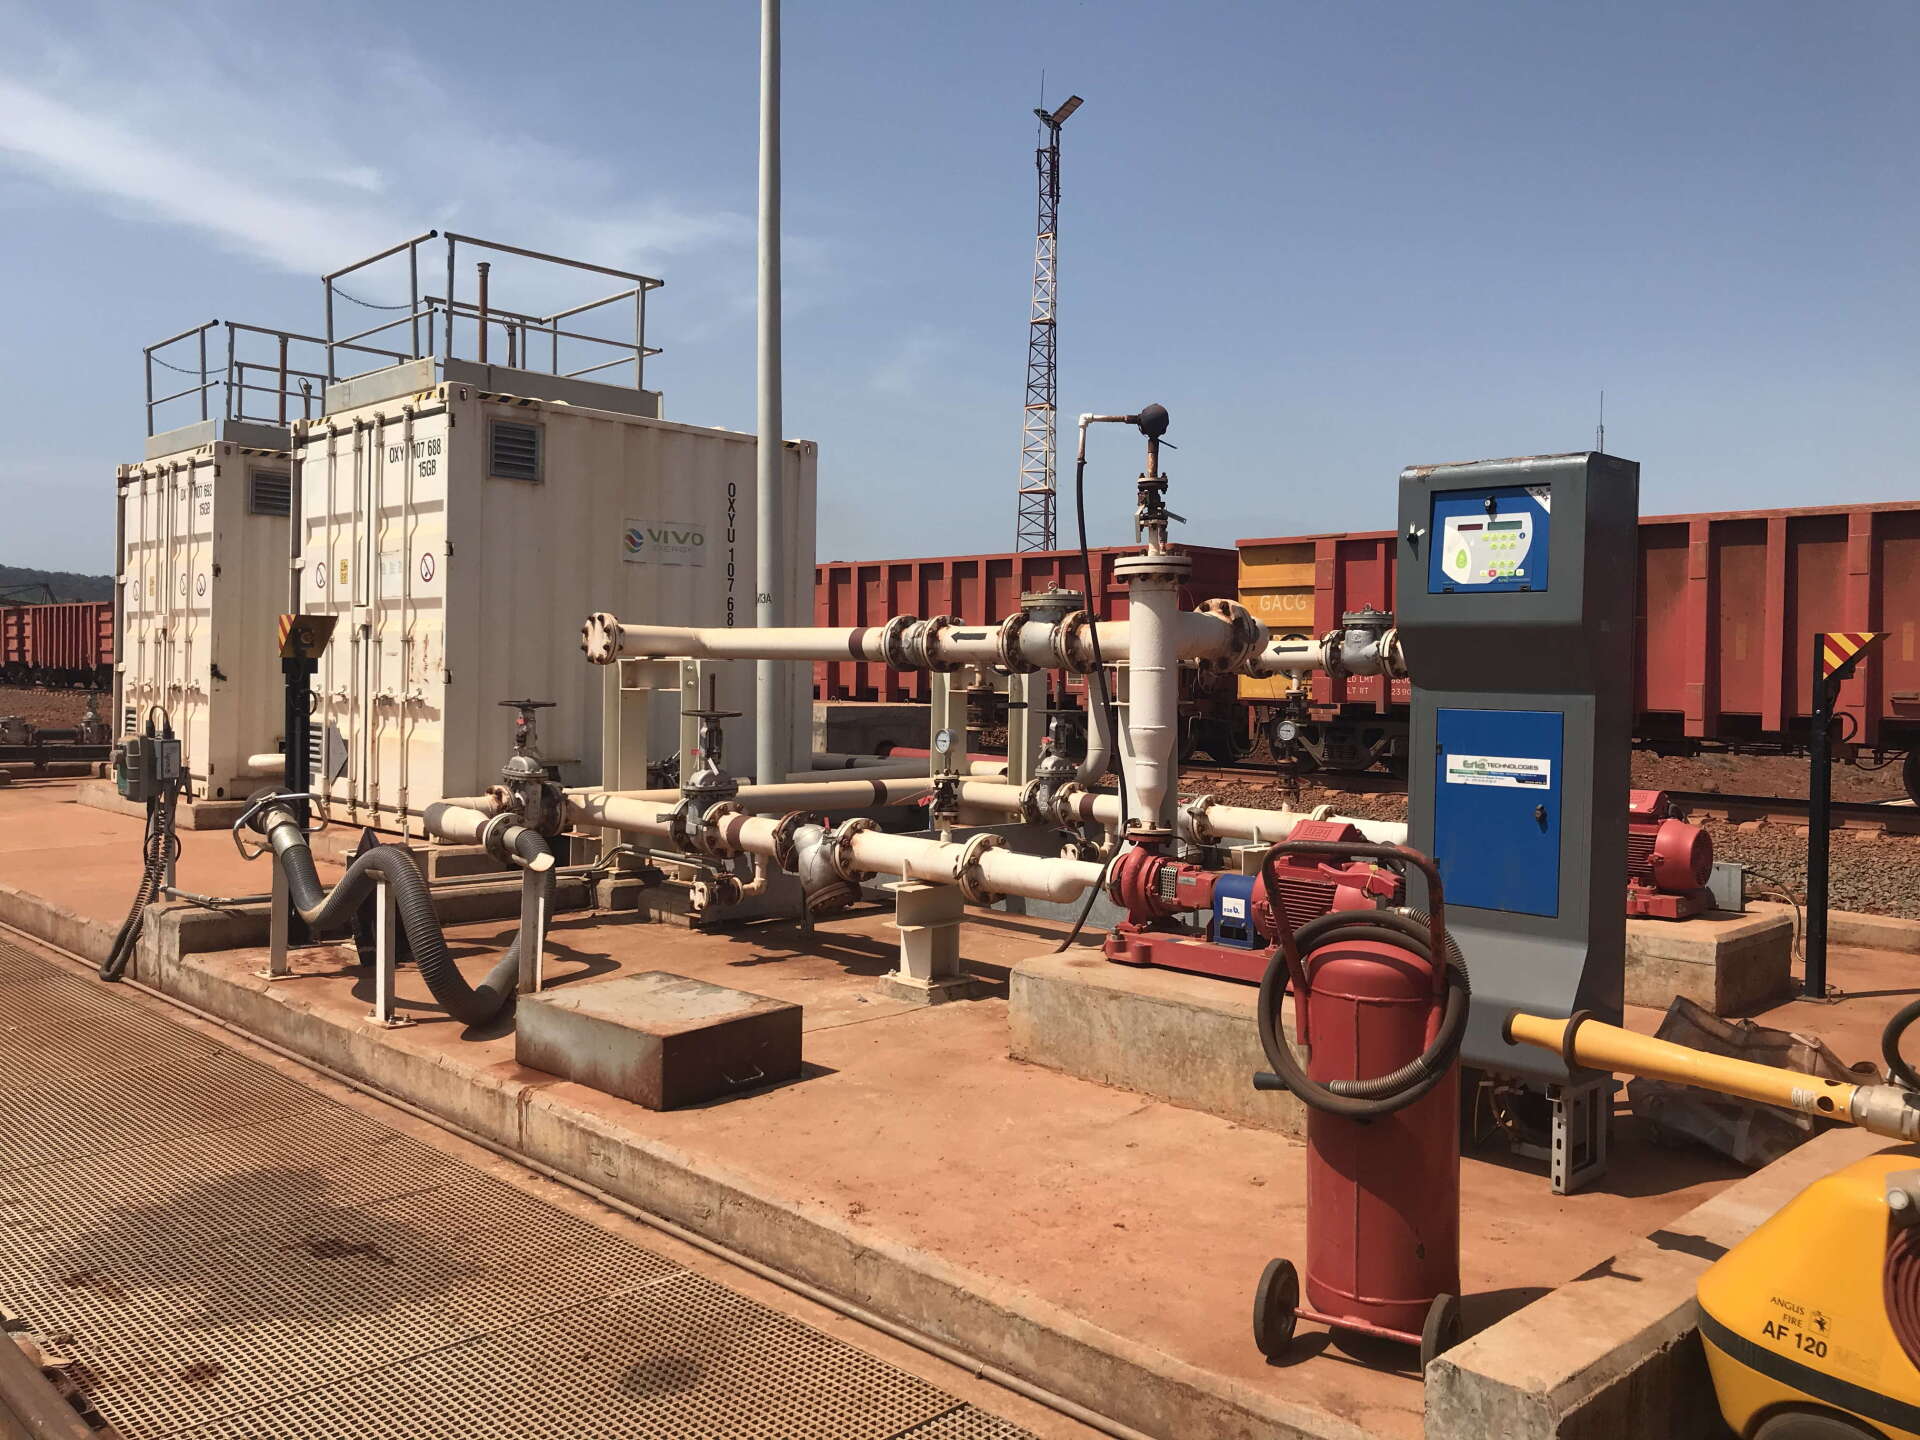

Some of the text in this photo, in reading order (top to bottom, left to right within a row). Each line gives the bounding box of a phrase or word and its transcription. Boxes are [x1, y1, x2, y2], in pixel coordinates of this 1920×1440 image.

[389, 445, 405, 463] OXY
[427, 438, 441, 456] 688
[418, 459, 437, 477] 15GB
[647, 528, 705, 546] VIVO
[727, 482, 736, 628] OXYU 107 68
[1260, 594, 1306, 611] GACG
[1487, 762, 1539, 771] TECHNOLOGIES
[1770, 1296, 1806, 1315] ANGUS
[1783, 1313, 1803, 1328] FIRE
[1762, 1320, 1828, 1358] AF 120
